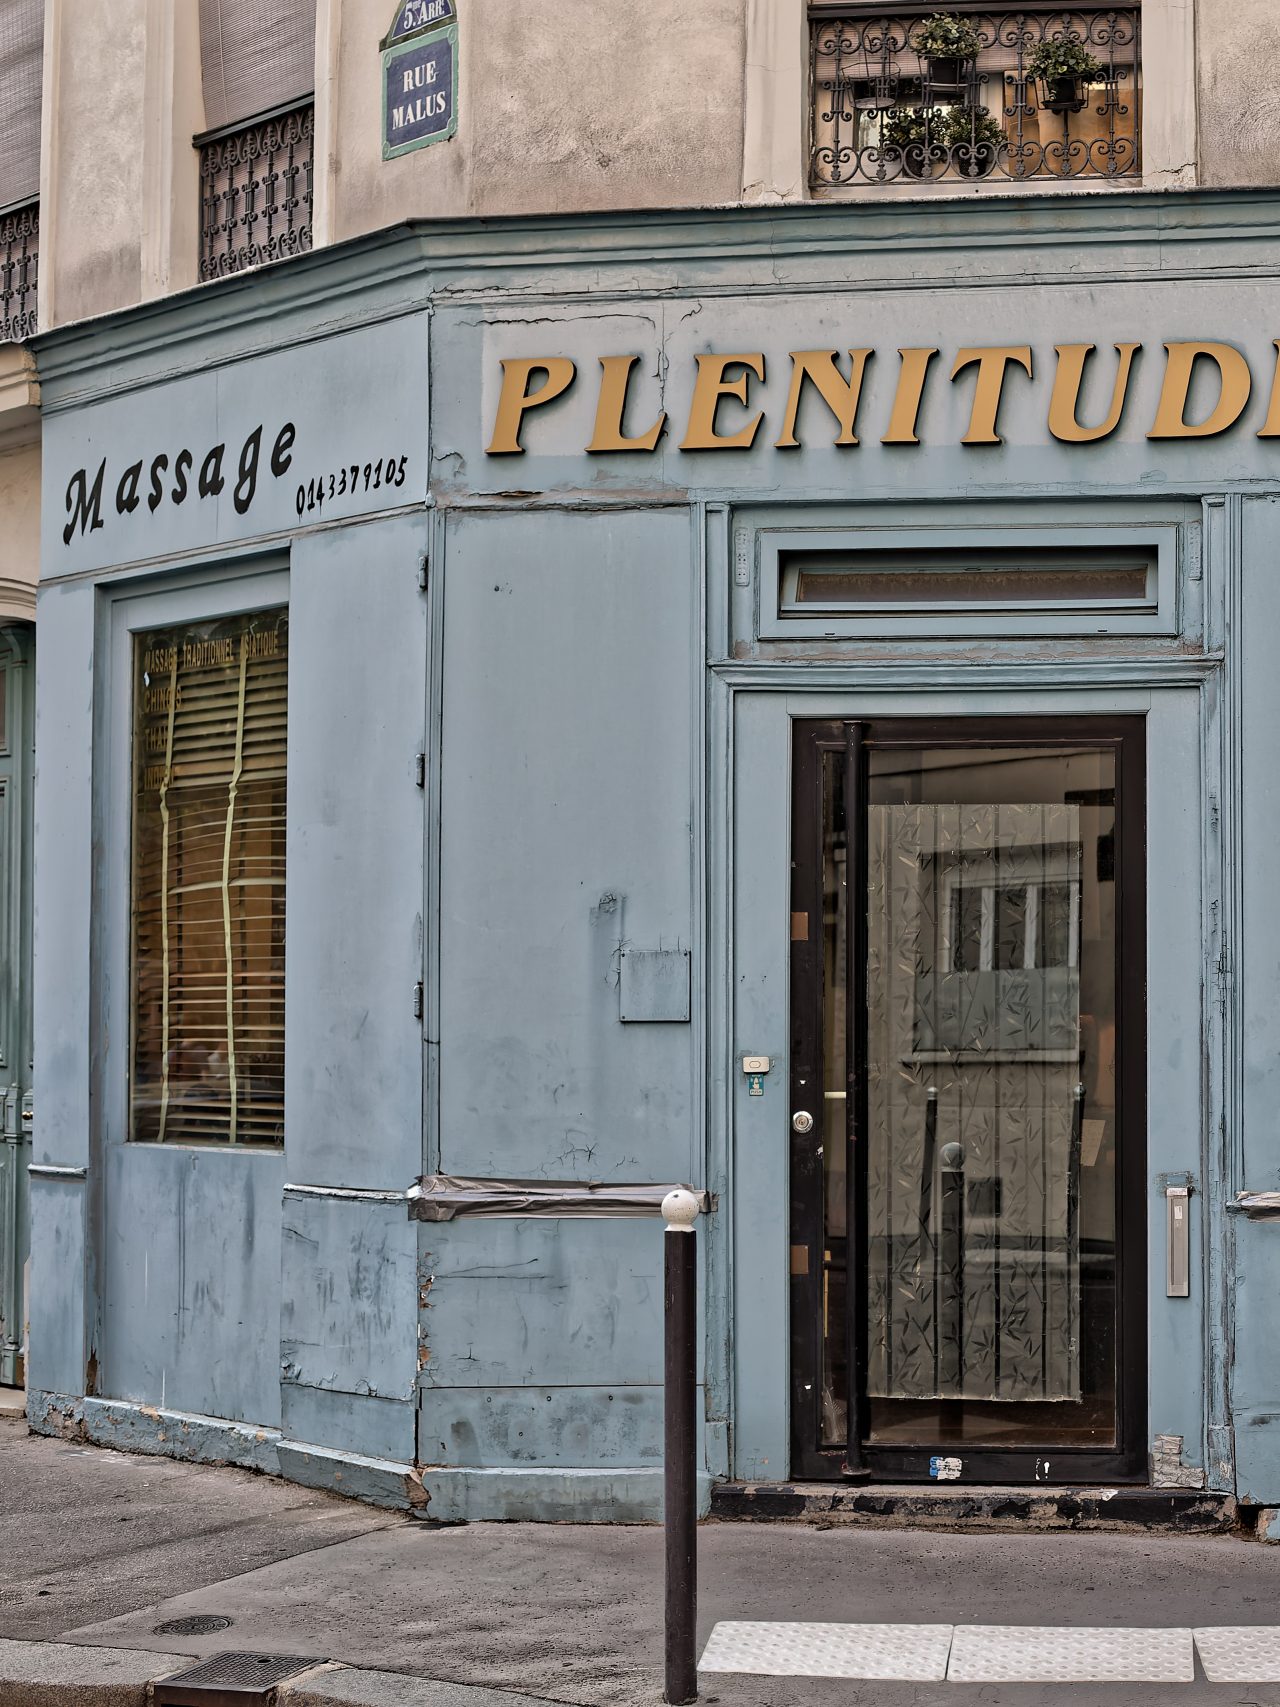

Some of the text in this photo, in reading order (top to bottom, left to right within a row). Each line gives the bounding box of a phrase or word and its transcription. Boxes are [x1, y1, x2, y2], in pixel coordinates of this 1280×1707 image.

[403, 61, 438, 93] RUE
[392, 91, 446, 130] MALUS
[63, 421, 296, 546] Massage
[296, 455, 408, 516] 0143379105
[183, 637, 234, 668] TRADITIONNEL
[144, 686, 182, 713] CHINOS
[144, 764, 174, 790] INDIN
